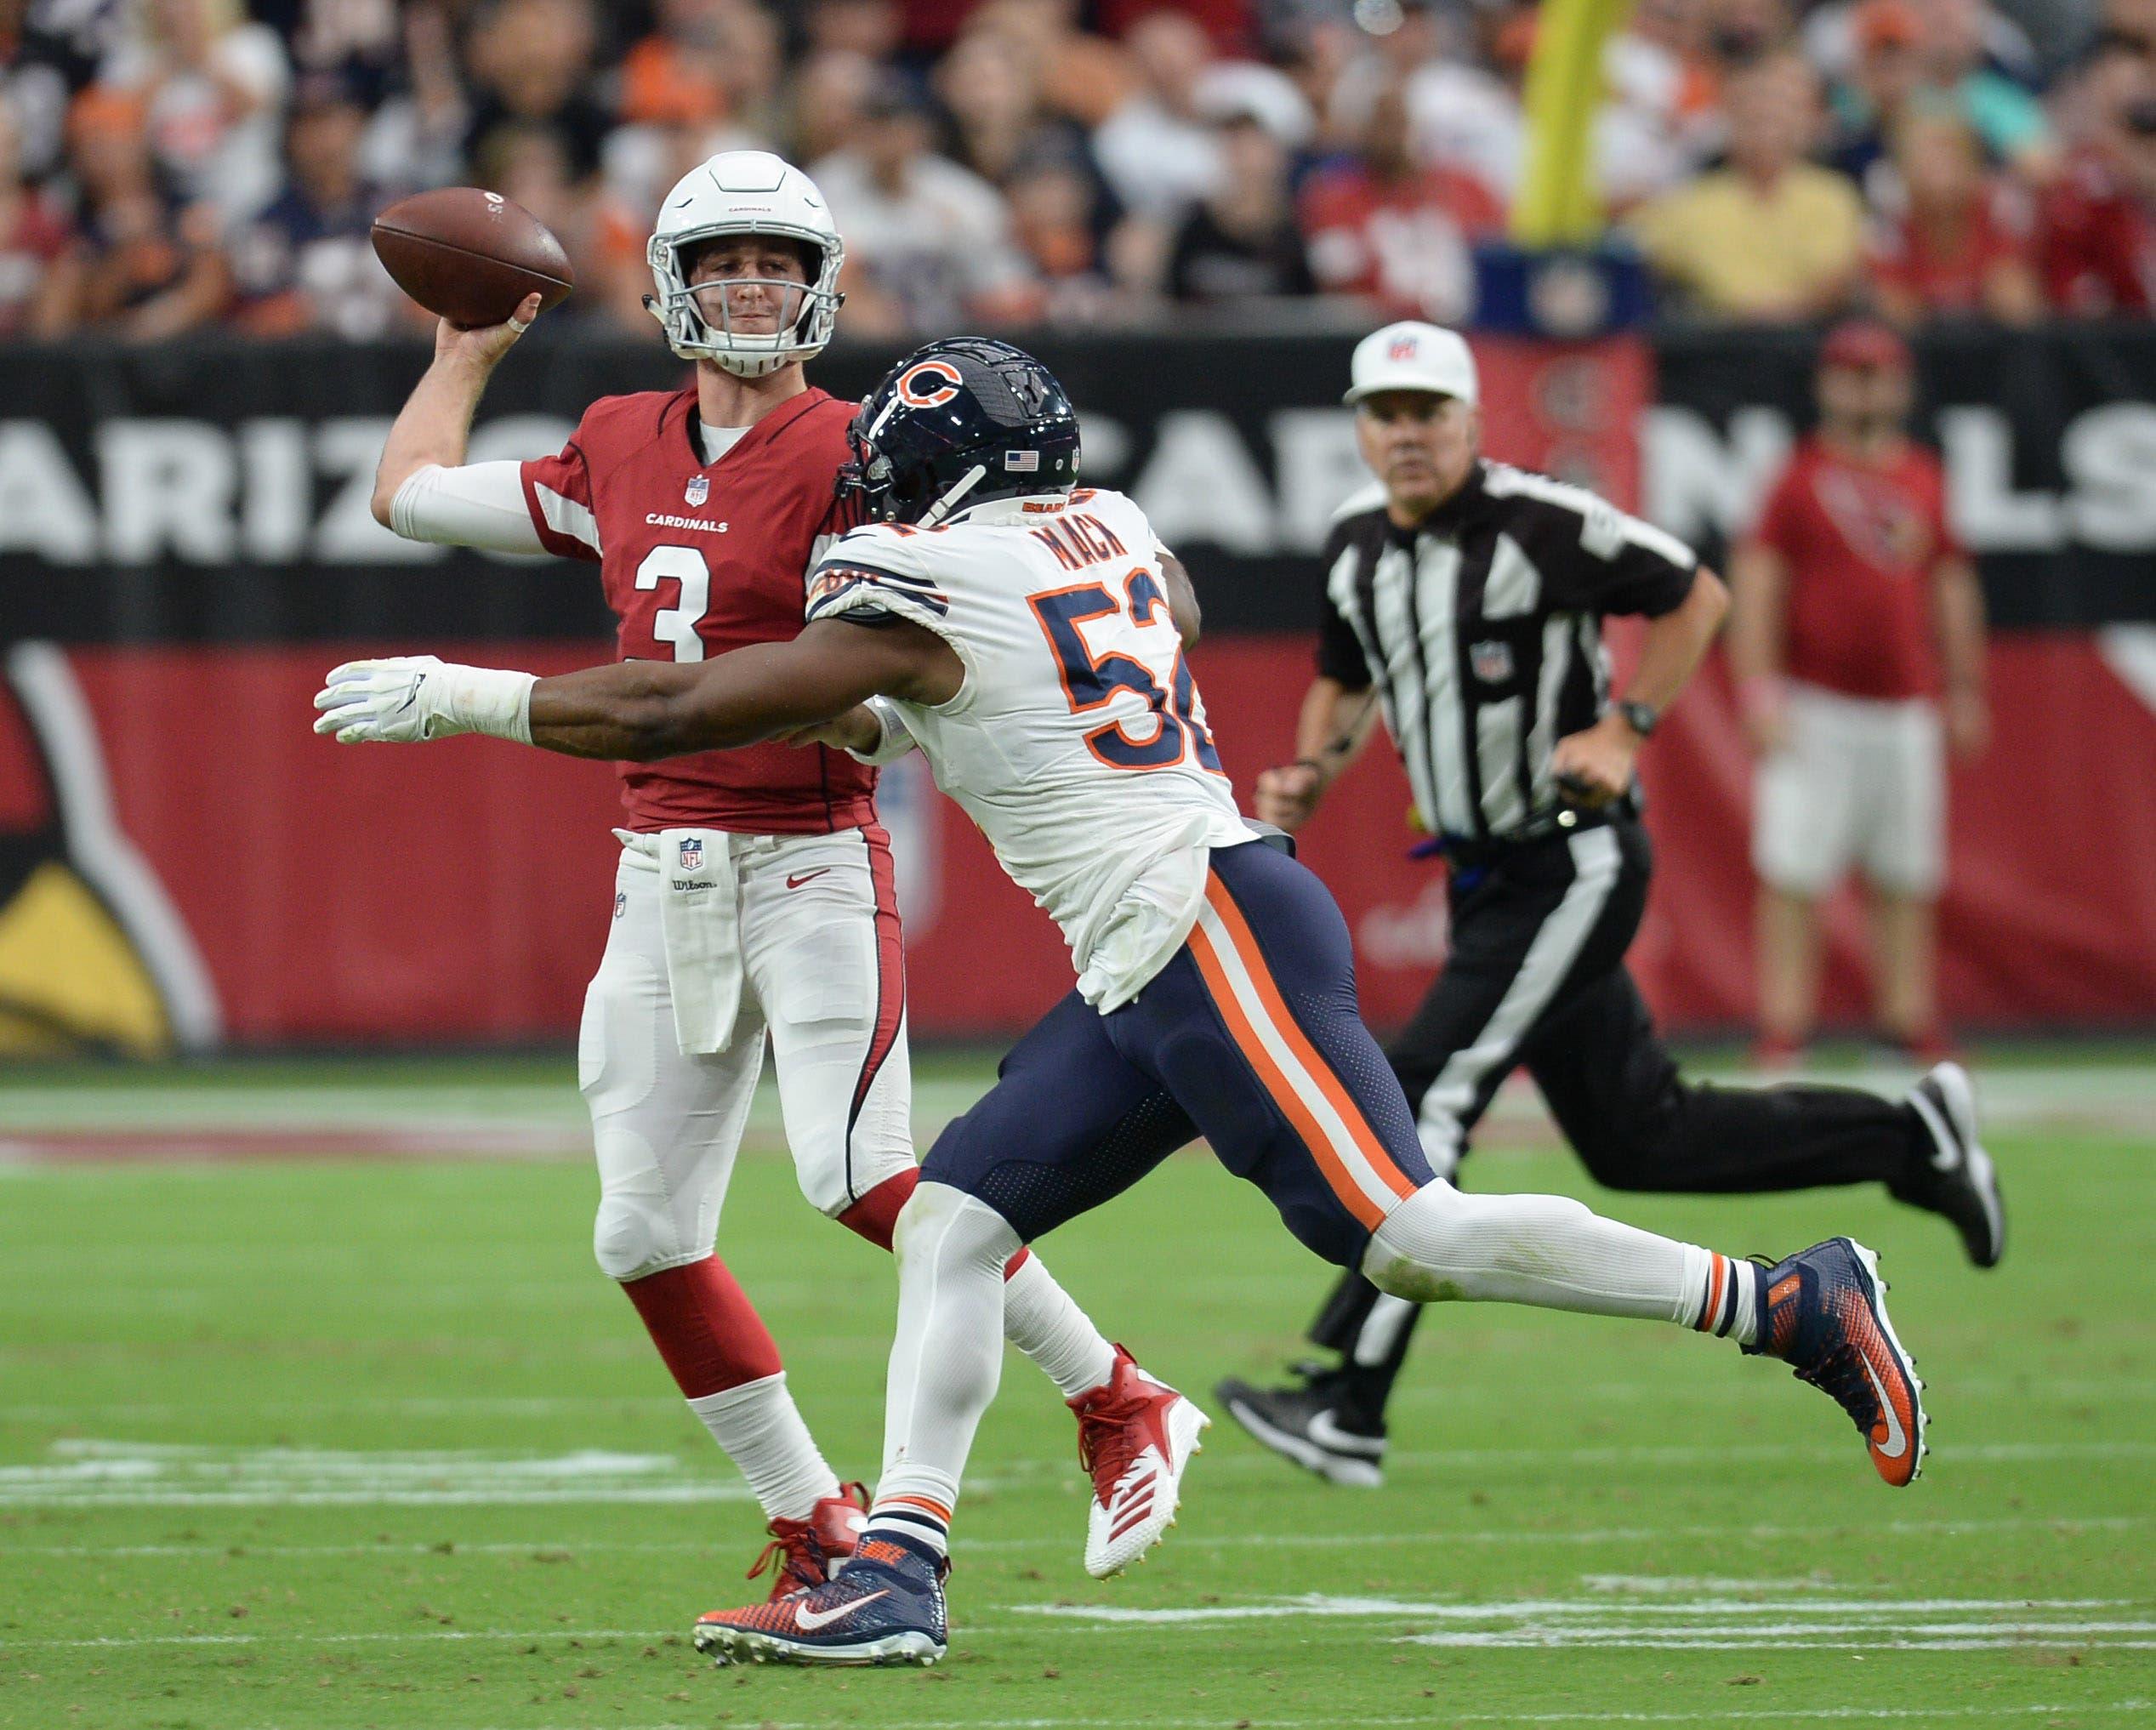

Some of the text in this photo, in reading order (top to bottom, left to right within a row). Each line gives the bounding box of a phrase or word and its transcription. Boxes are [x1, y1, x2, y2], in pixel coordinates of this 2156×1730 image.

[646, 513, 728, 532] CARDINALS
[1028, 513, 1129, 571] MACK
[631, 543, 710, 663] 3
[1025, 567, 1226, 776] 52
[672, 879, 716, 891] Wilson
